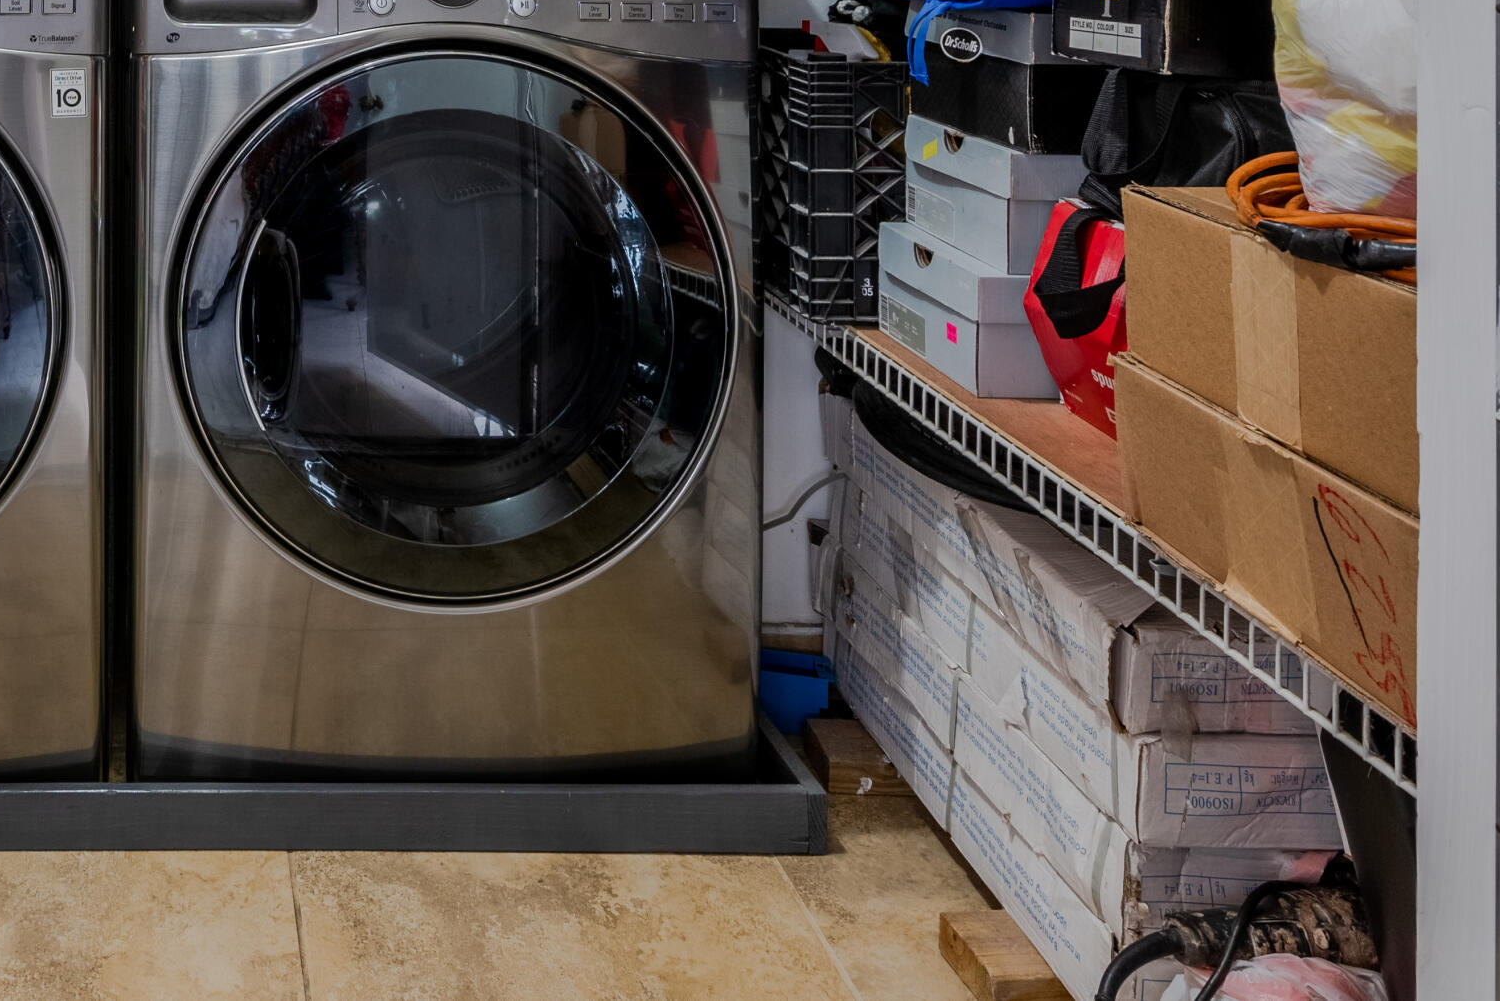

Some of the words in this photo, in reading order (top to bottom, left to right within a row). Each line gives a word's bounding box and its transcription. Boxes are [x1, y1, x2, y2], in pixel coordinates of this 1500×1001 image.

[51, 2, 67, 10] Signal
[1072, 19, 1086, 29] STYLE
[1096, 22, 1115, 32] COLOUR
[1124, 25, 1135, 35] SIZE
[37, 34, 75, 43] TrueBalance
[56, 88, 82, 108] 10
[862, 278, 871, 287] 3
[861, 288, 874, 297] 05
